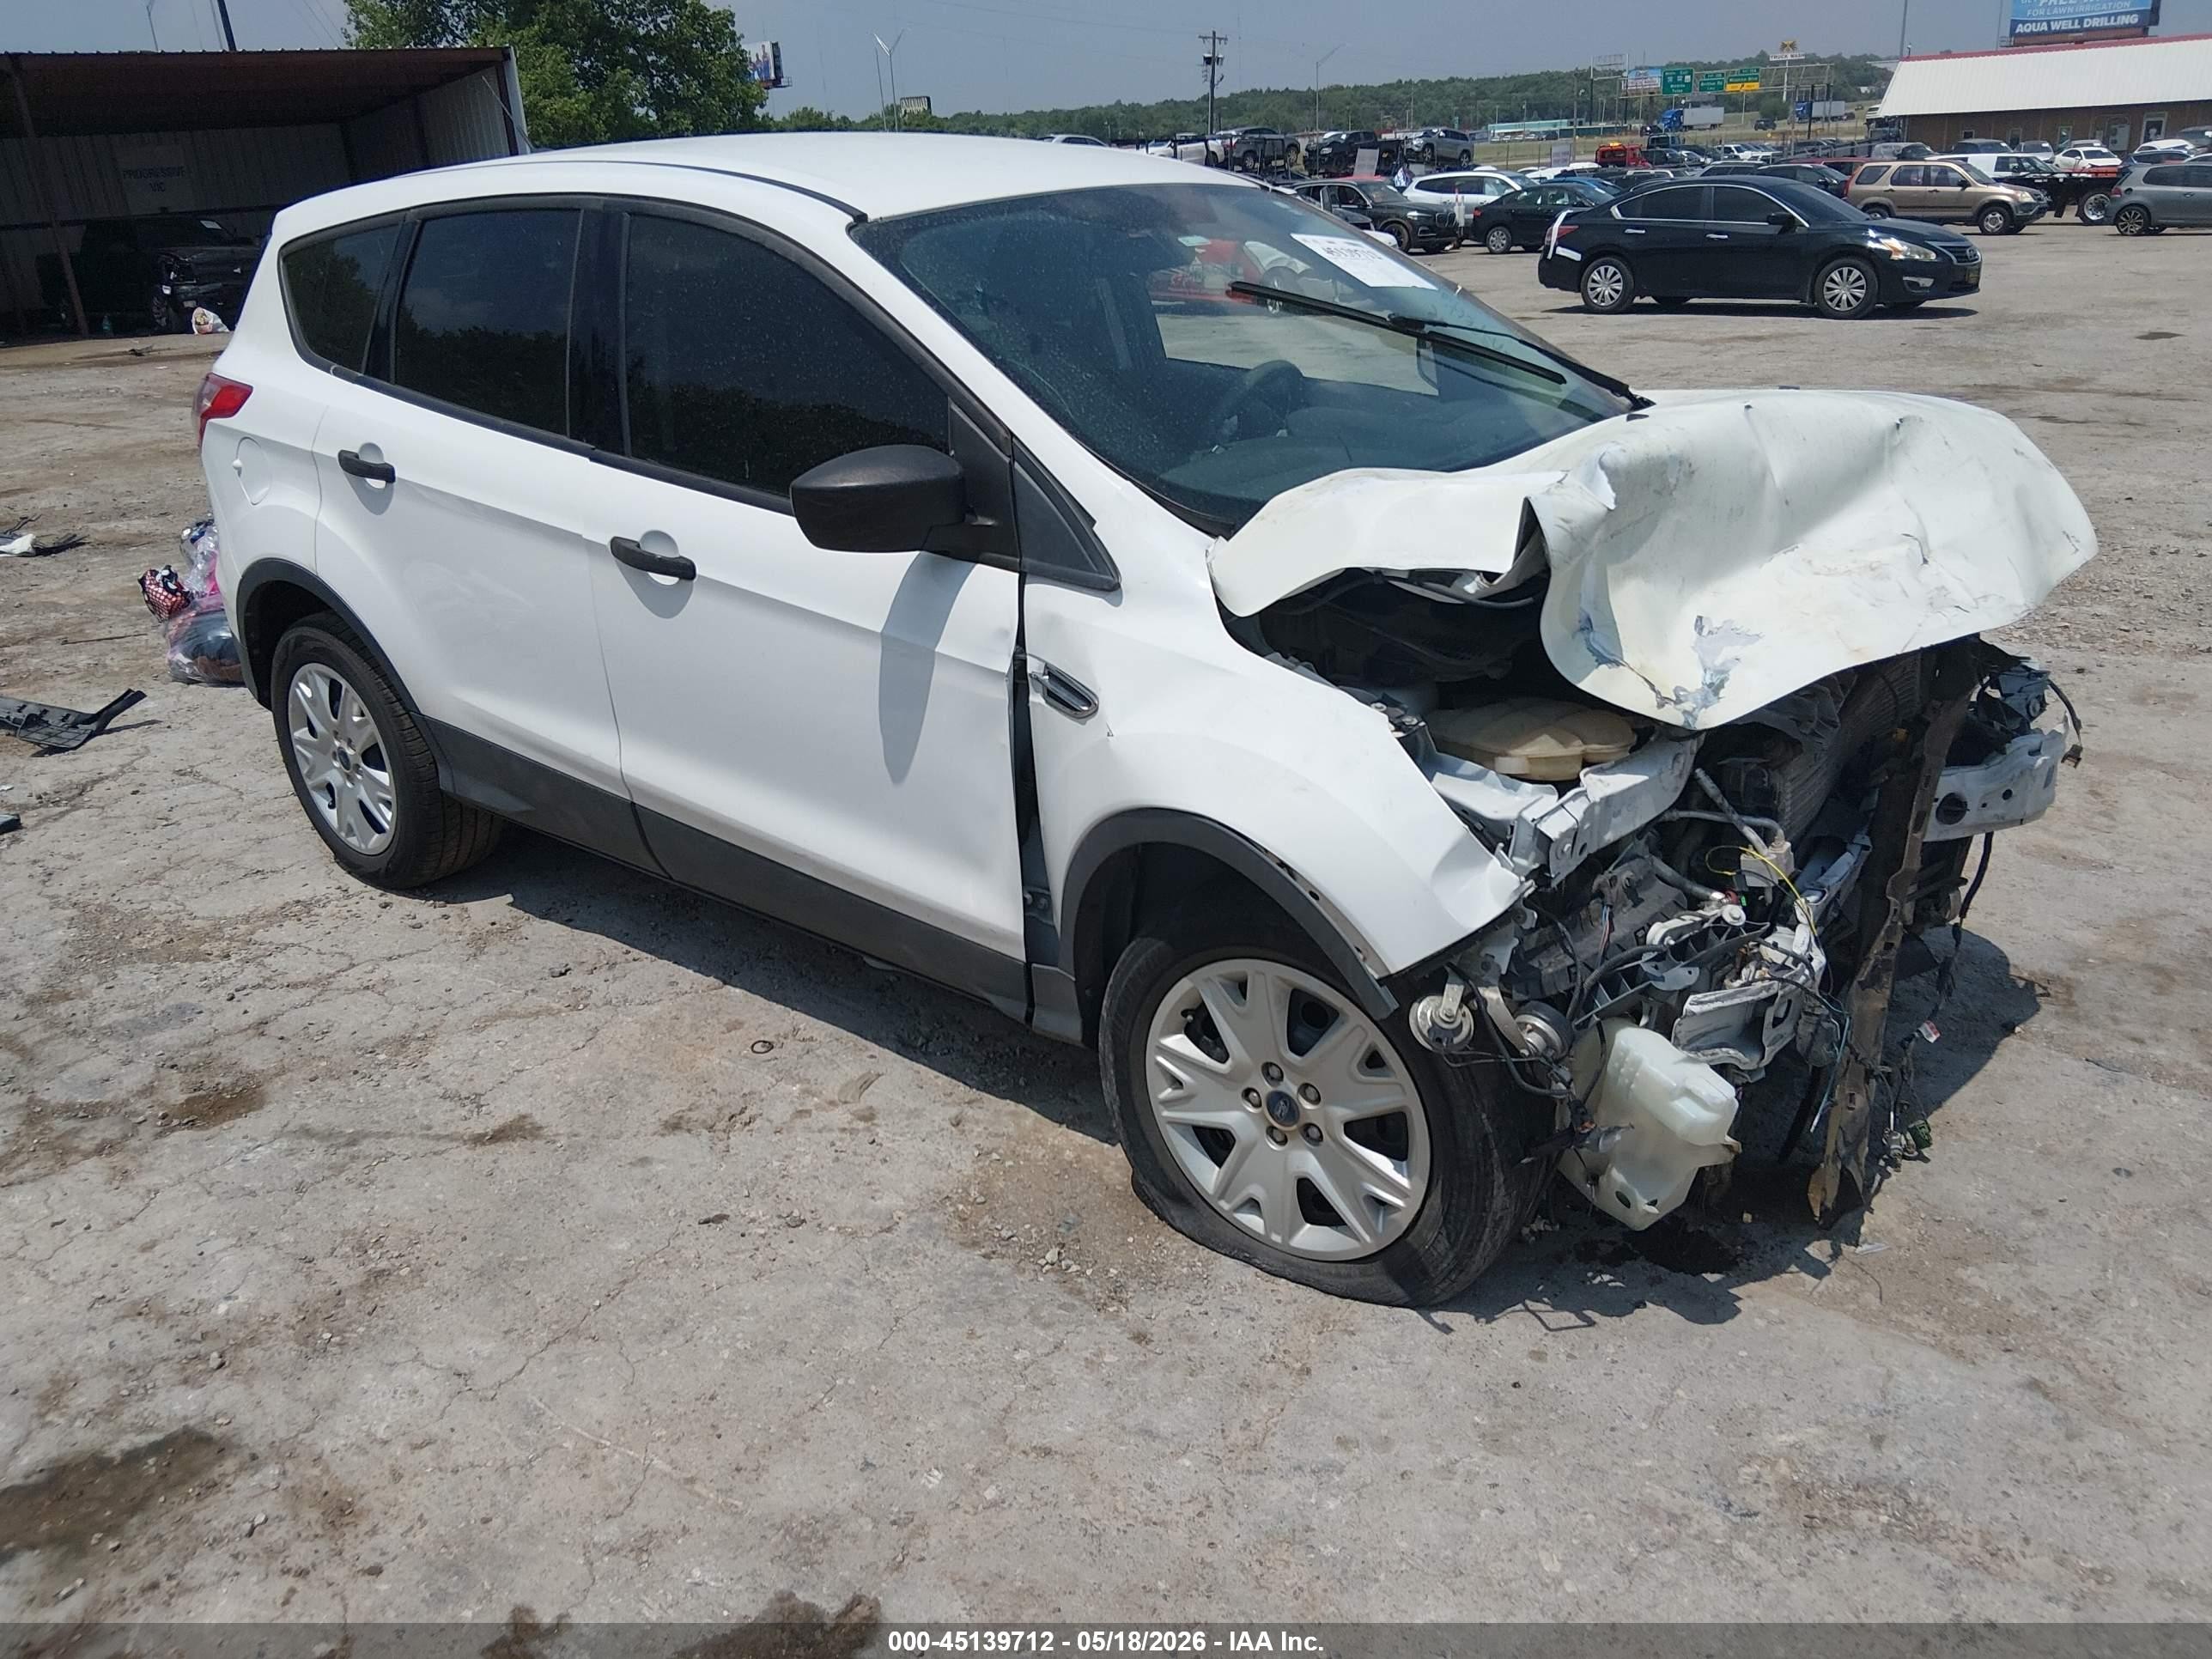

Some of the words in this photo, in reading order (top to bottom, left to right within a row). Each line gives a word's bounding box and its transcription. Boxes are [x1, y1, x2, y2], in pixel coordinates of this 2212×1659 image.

[2027, 9, 2047, 17] FOR
[2047, 6, 2075, 15] LAWN
[2075, 1, 2130, 14] IRRIGATION
[2015, 22, 2048, 33] AQUA
[2050, 19, 2081, 31] WELL
[2083, 14, 2139, 27] DRILLING
